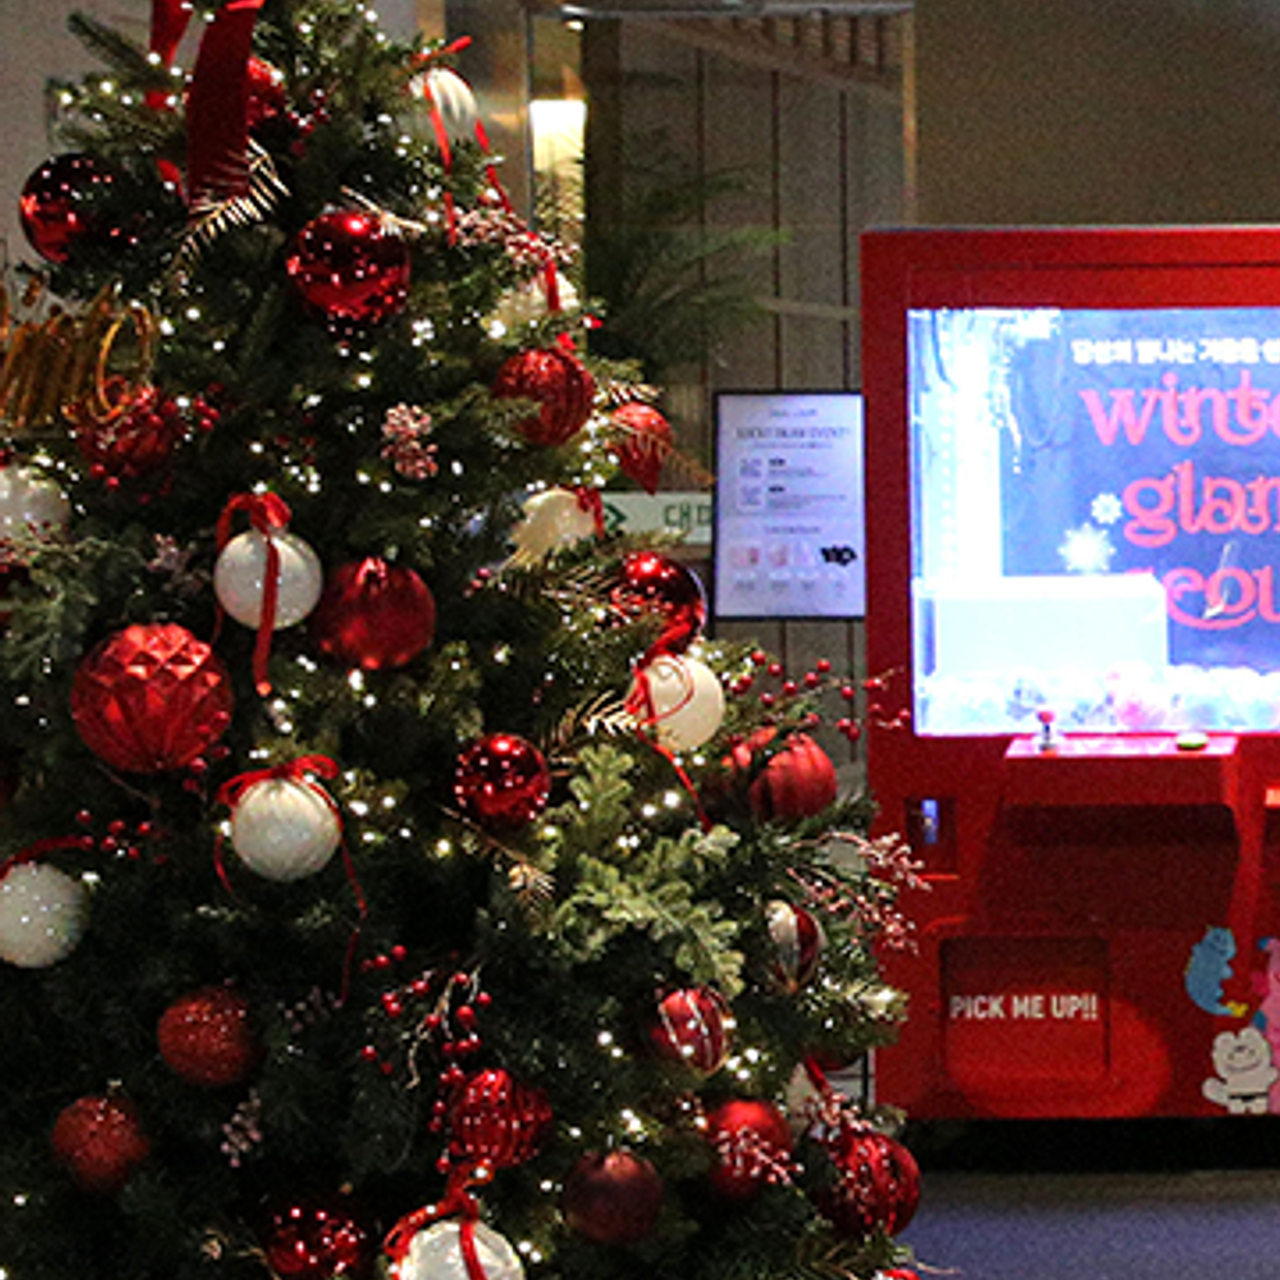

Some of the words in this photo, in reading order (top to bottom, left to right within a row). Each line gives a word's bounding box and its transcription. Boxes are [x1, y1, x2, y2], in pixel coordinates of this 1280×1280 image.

[950, 995, 1005, 1019] PICK
[1012, 995, 1046, 1019] ME
[1051, 993, 1098, 1020] UP!!
